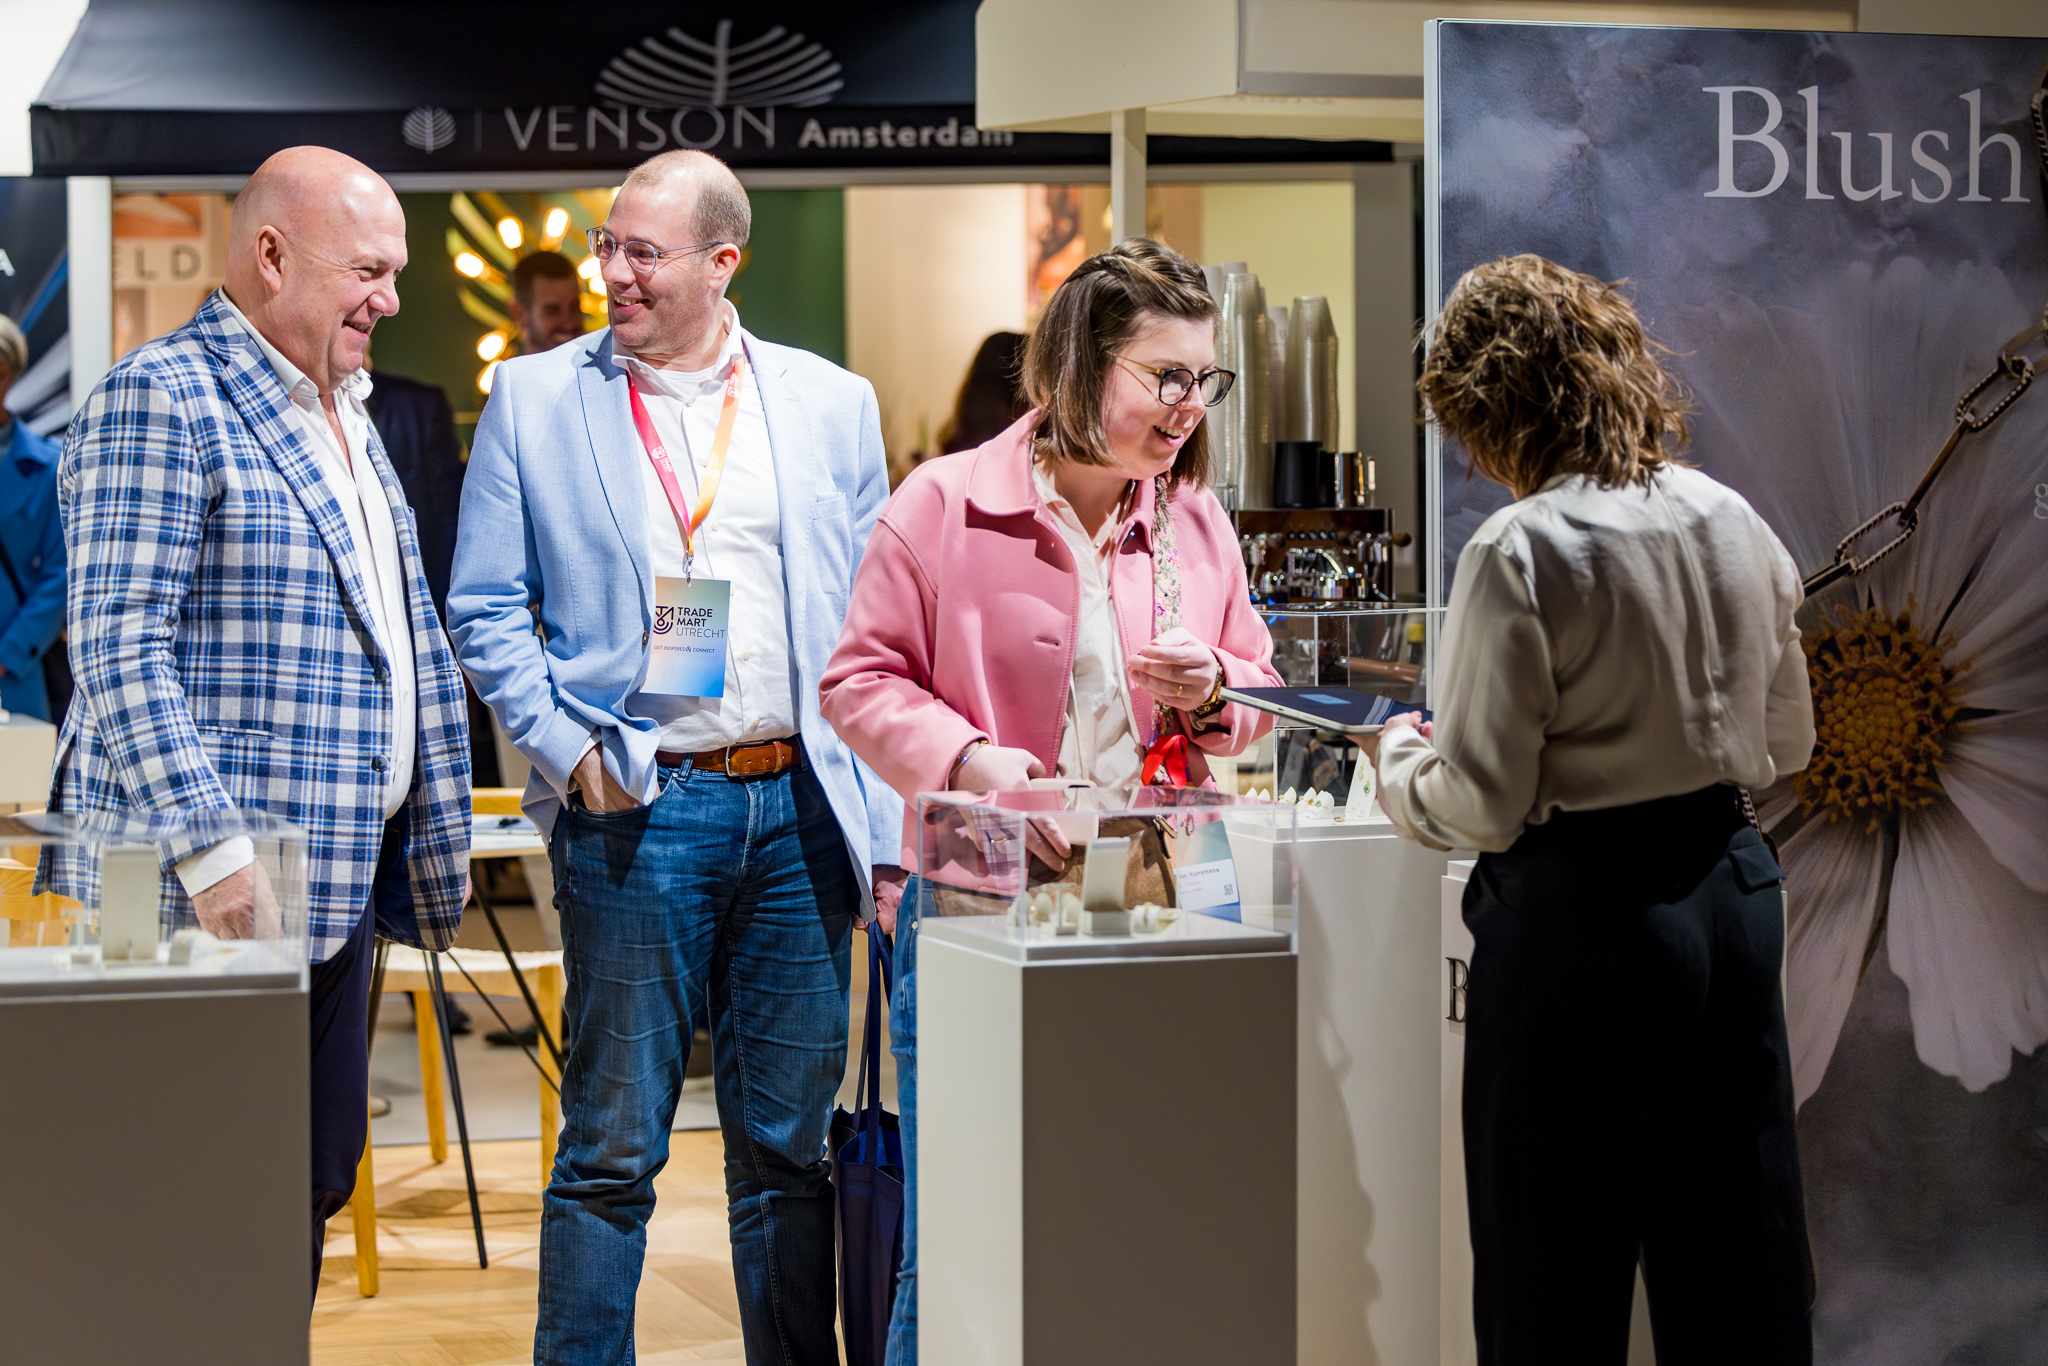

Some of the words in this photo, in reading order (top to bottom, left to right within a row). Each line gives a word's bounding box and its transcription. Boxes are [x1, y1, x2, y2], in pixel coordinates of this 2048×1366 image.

[503, 104, 776, 151] VENSON
[797, 116, 1015, 149] Amsterdam
[1702, 85, 2031, 203] Blush
[112, 245, 201, 281] LD
[676, 618, 707, 627] MART
[677, 606, 713, 618] TRADE
[676, 627, 726, 639] UTRECHT
